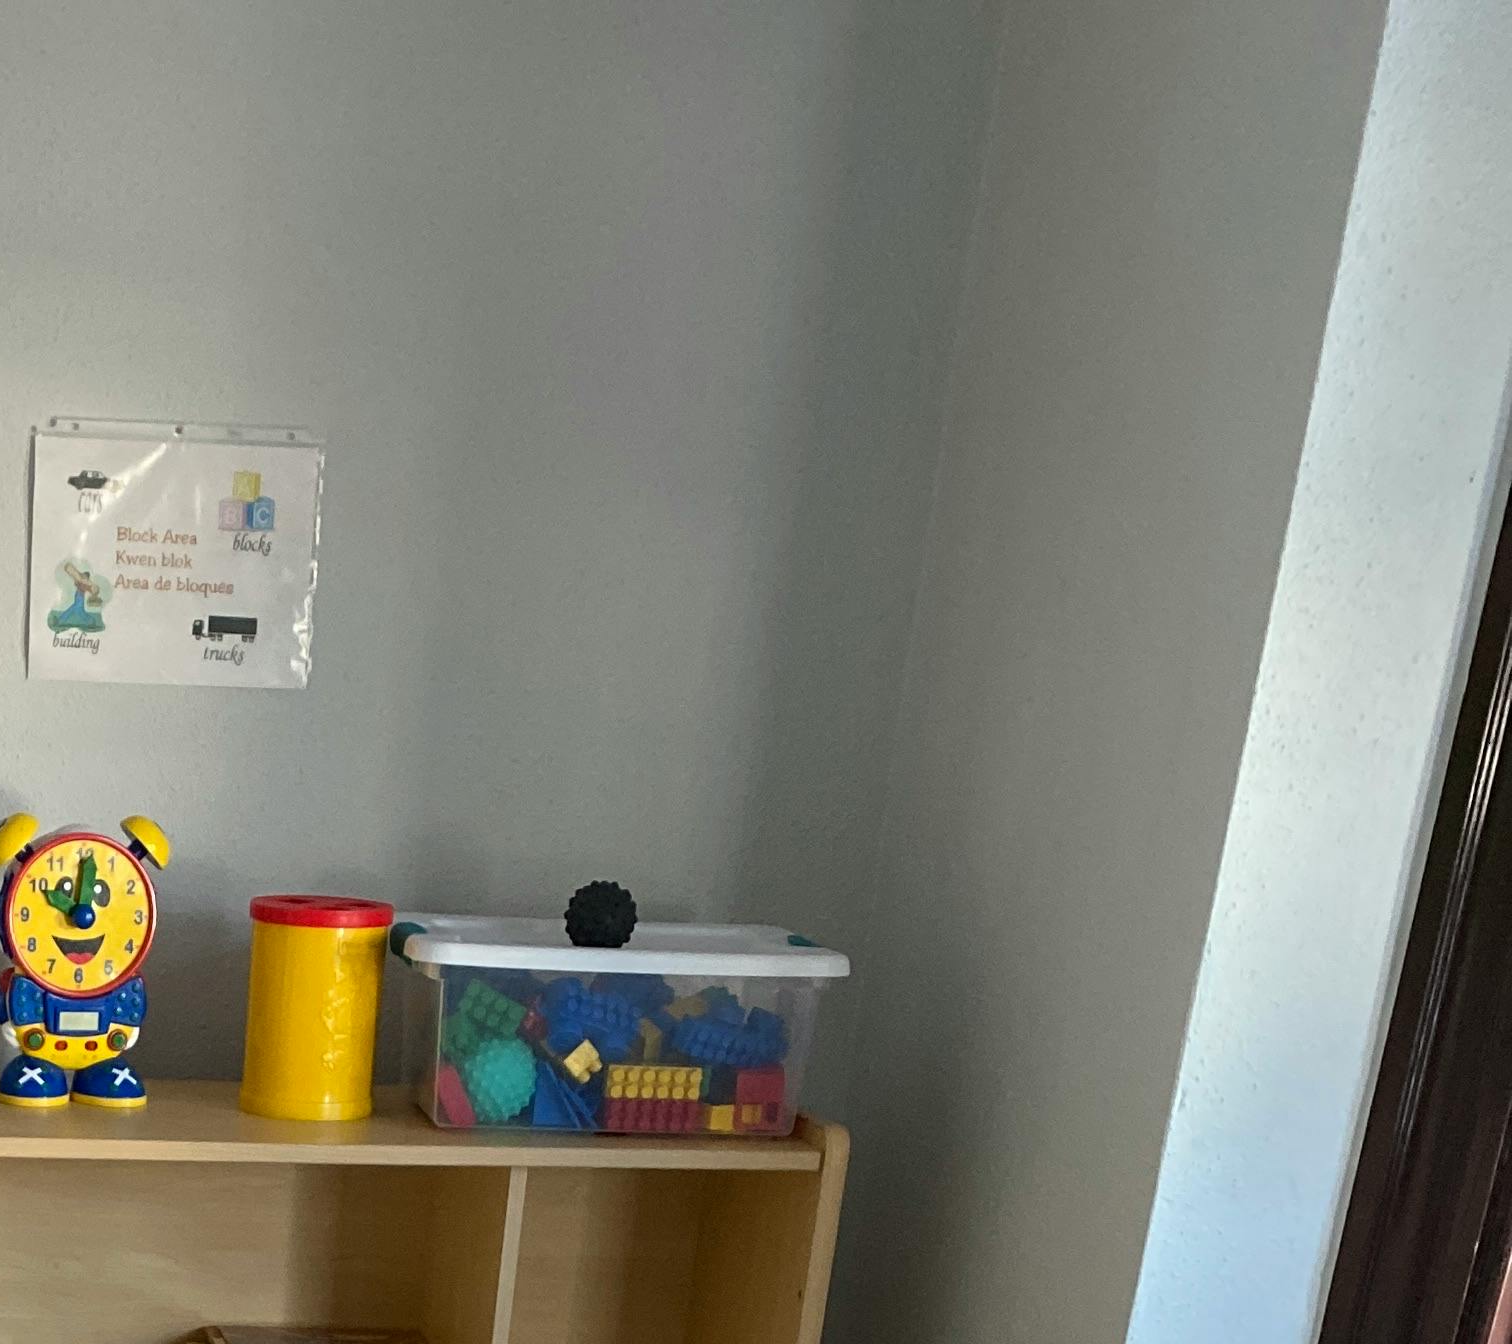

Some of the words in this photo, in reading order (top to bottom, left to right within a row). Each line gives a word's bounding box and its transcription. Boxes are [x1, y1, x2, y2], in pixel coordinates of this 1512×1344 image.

[116, 526, 159, 545] Block
[160, 528, 198, 546] Area
[232, 532, 273, 557] blocks
[115, 552, 157, 569] Kwen
[160, 554, 193, 570] blok
[114, 575, 149, 592] Area
[153, 577, 172, 592] de
[176, 578, 234, 598] bloques
[52, 633, 100, 655] building
[203, 645, 245, 666] trucks
[46, 855, 64, 872] 11
[107, 856, 115, 873] 1
[29, 877, 48, 892] 10
[126, 879, 136, 894] 2
[20, 907, 30, 922] 9
[134, 910, 144, 925] 3
[27, 938, 37, 953] 8
[124, 939, 134, 954] 4
[46, 958, 57, 975] 7
[104, 960, 114, 976] 5
[74, 967, 84, 984] 6
